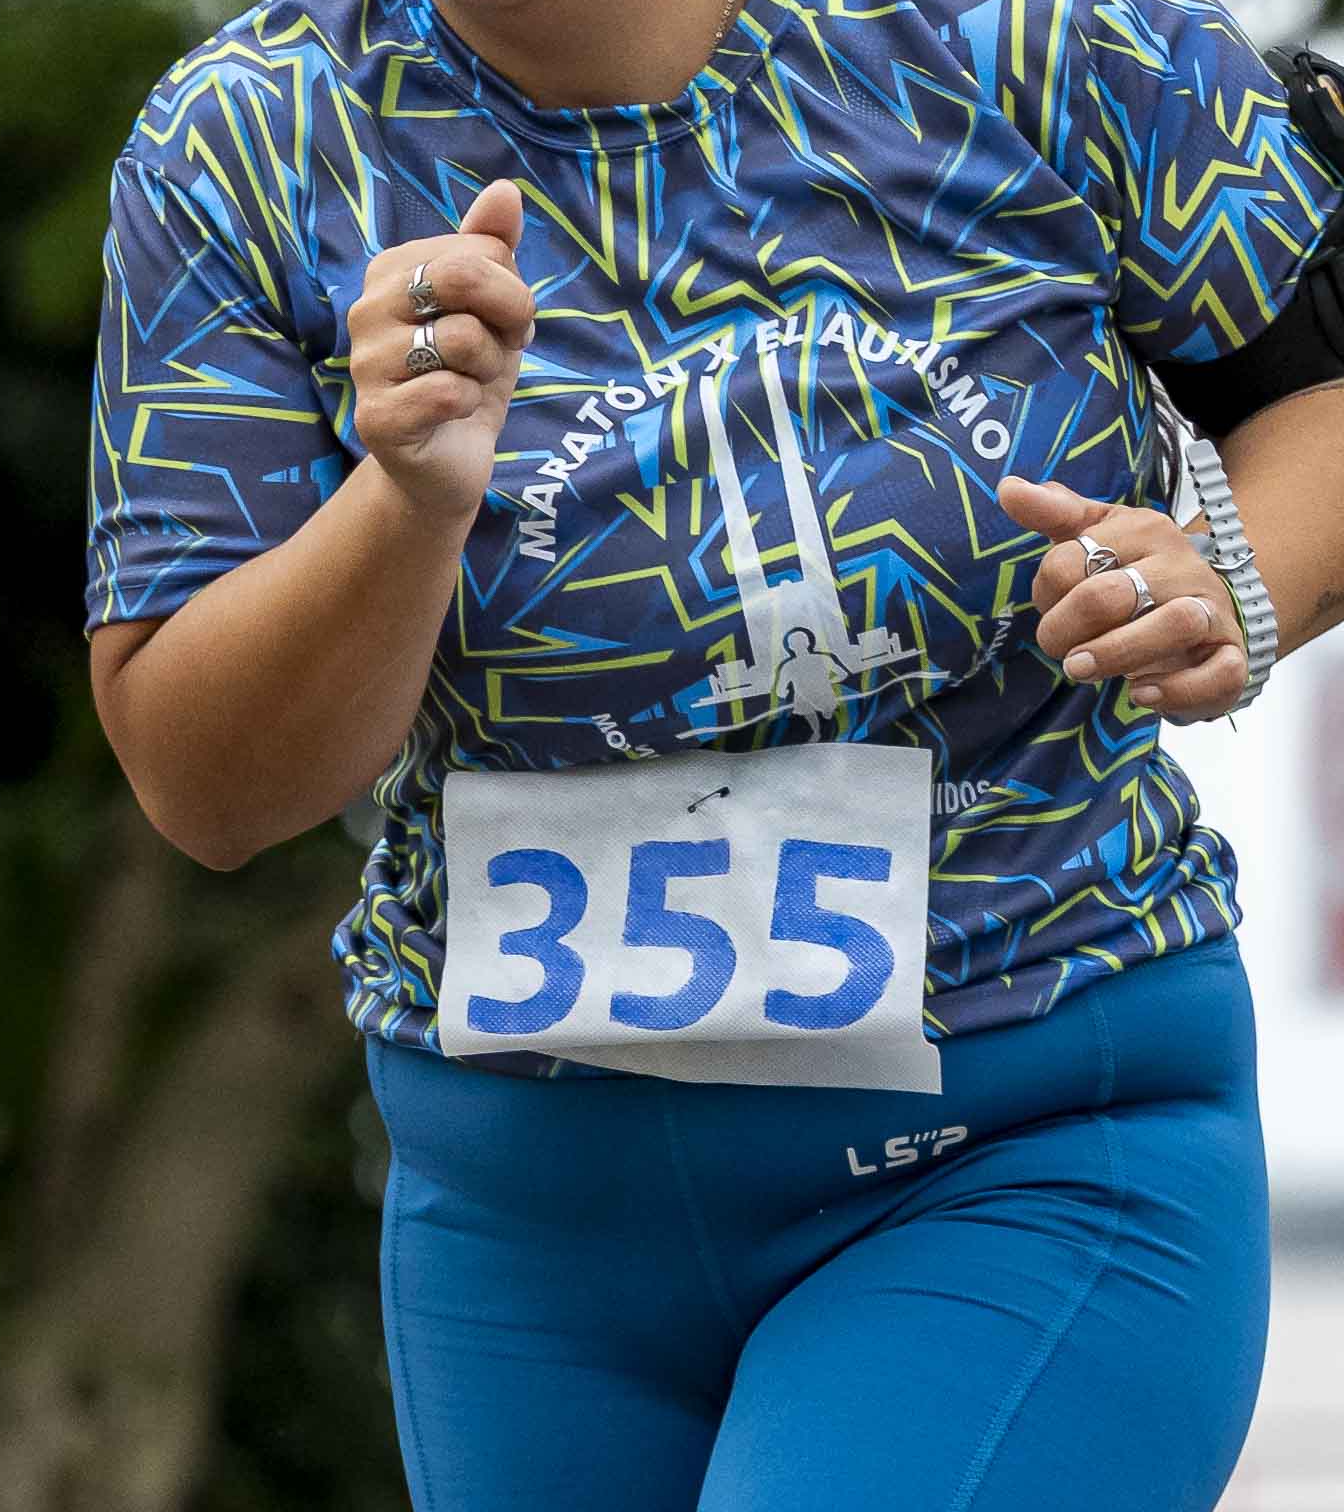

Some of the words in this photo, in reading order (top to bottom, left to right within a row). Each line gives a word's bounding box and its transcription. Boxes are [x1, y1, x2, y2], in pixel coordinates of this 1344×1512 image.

[519, 360, 690, 563] MARATÓN
[703, 331, 740, 372] X
[756, 316, 804, 354] EL
[817, 311, 1011, 460] AUTISMO
[466, 837, 895, 1035] 355
